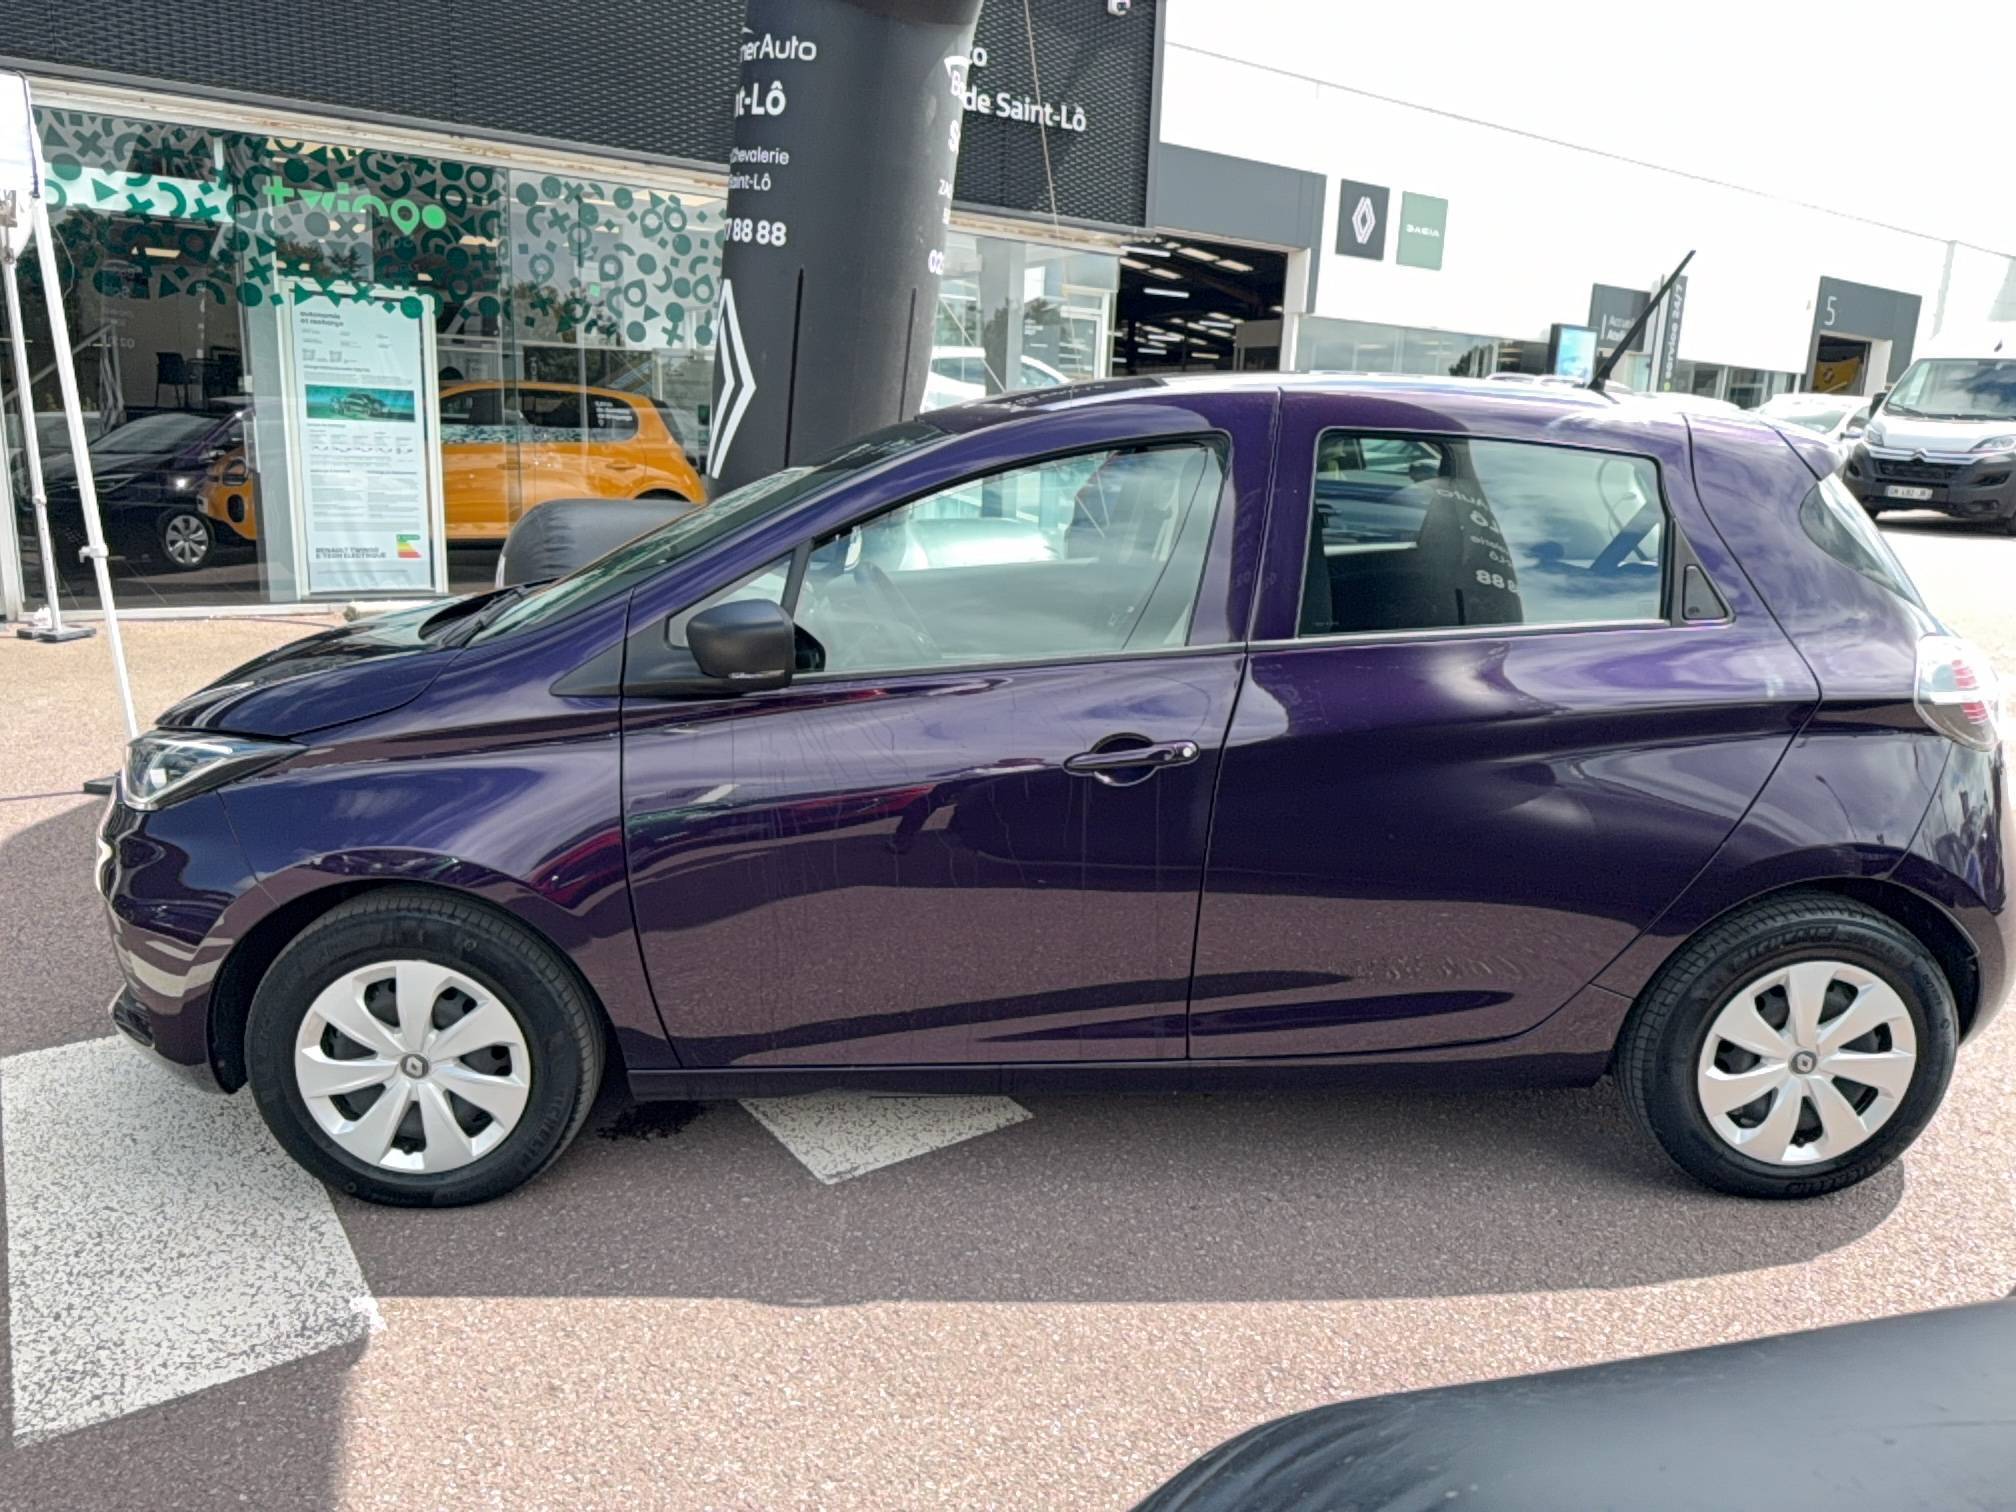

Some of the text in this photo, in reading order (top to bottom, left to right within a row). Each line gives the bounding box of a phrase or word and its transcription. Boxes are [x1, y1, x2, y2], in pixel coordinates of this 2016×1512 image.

[995, 91, 1087, 132] Saint-Lô
[755, 220, 787, 247] 88
[1823, 295, 1838, 327] 5
